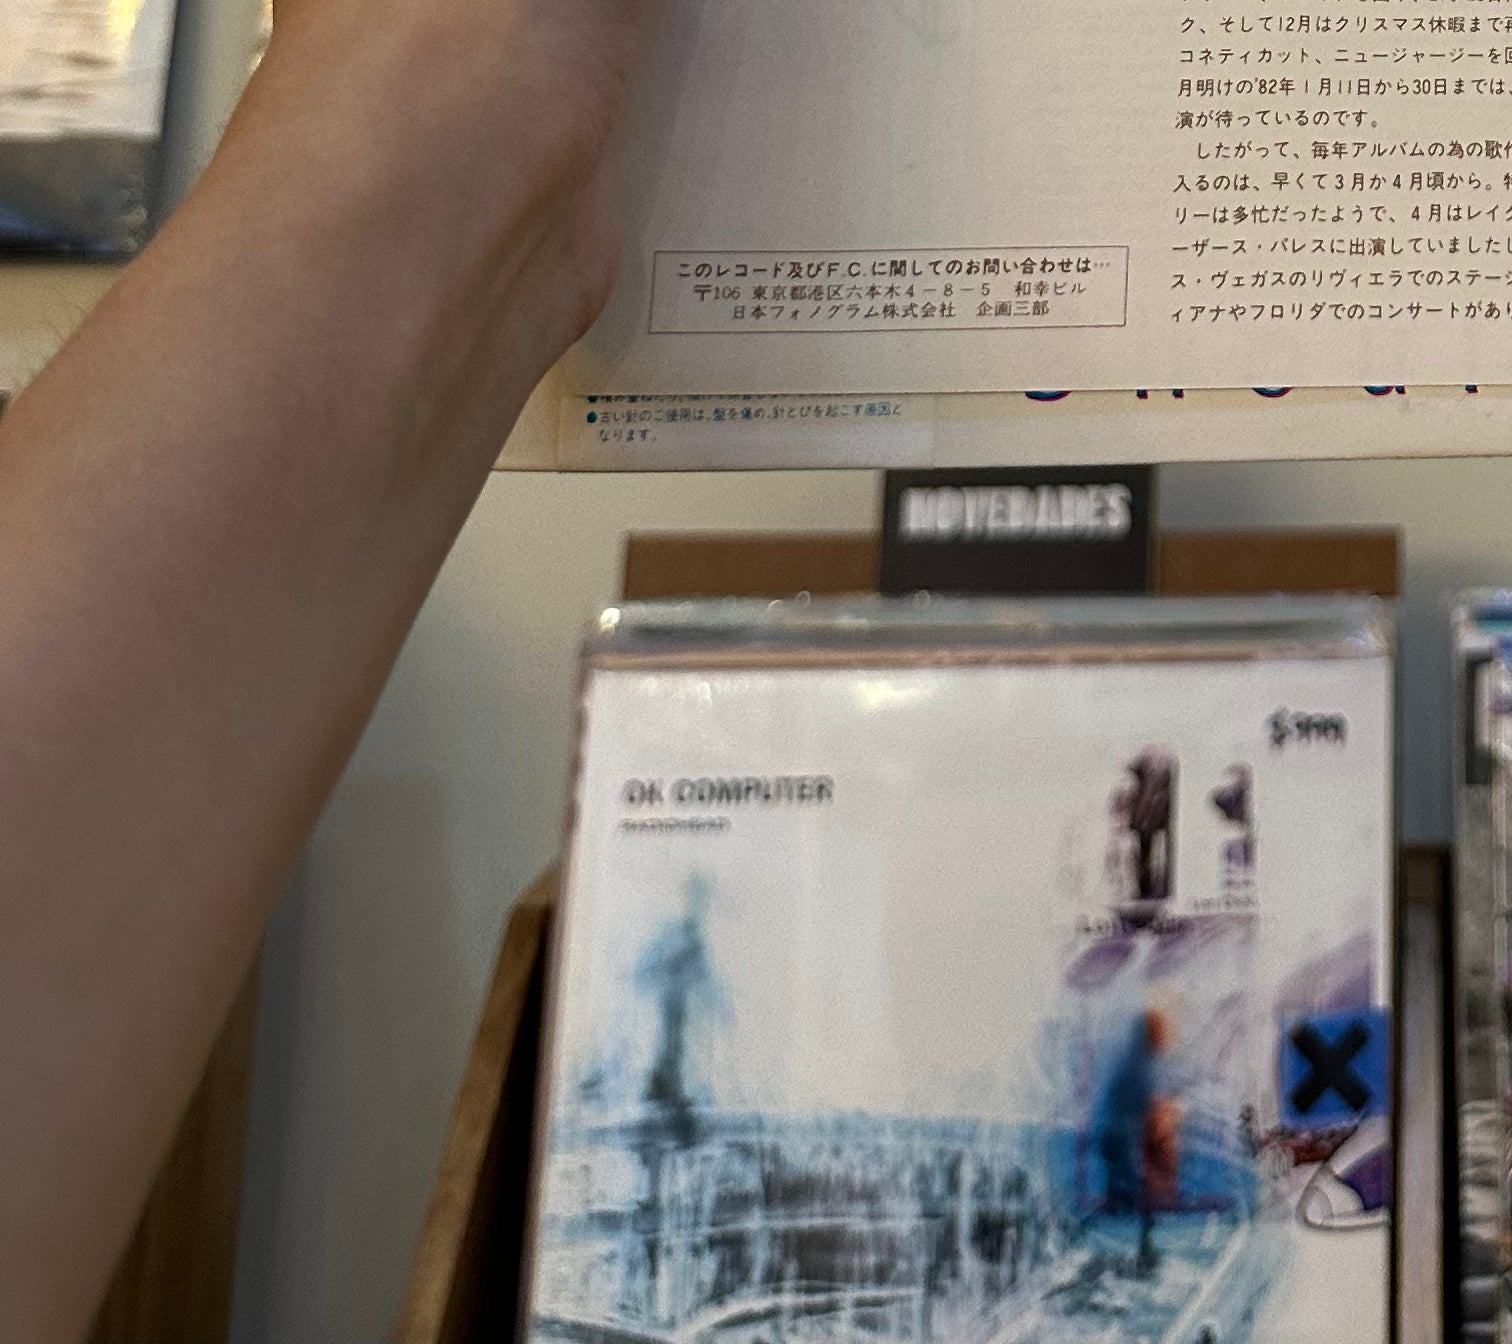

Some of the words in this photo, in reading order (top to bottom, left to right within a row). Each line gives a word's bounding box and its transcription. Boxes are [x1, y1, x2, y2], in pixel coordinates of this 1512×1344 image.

[1174, 108, 1377, 130] 演が待っているのです。
[899, 483, 1133, 543] NOVEDADES
[620, 774, 665, 807] OK
[669, 773, 836, 806] COMPUTER
